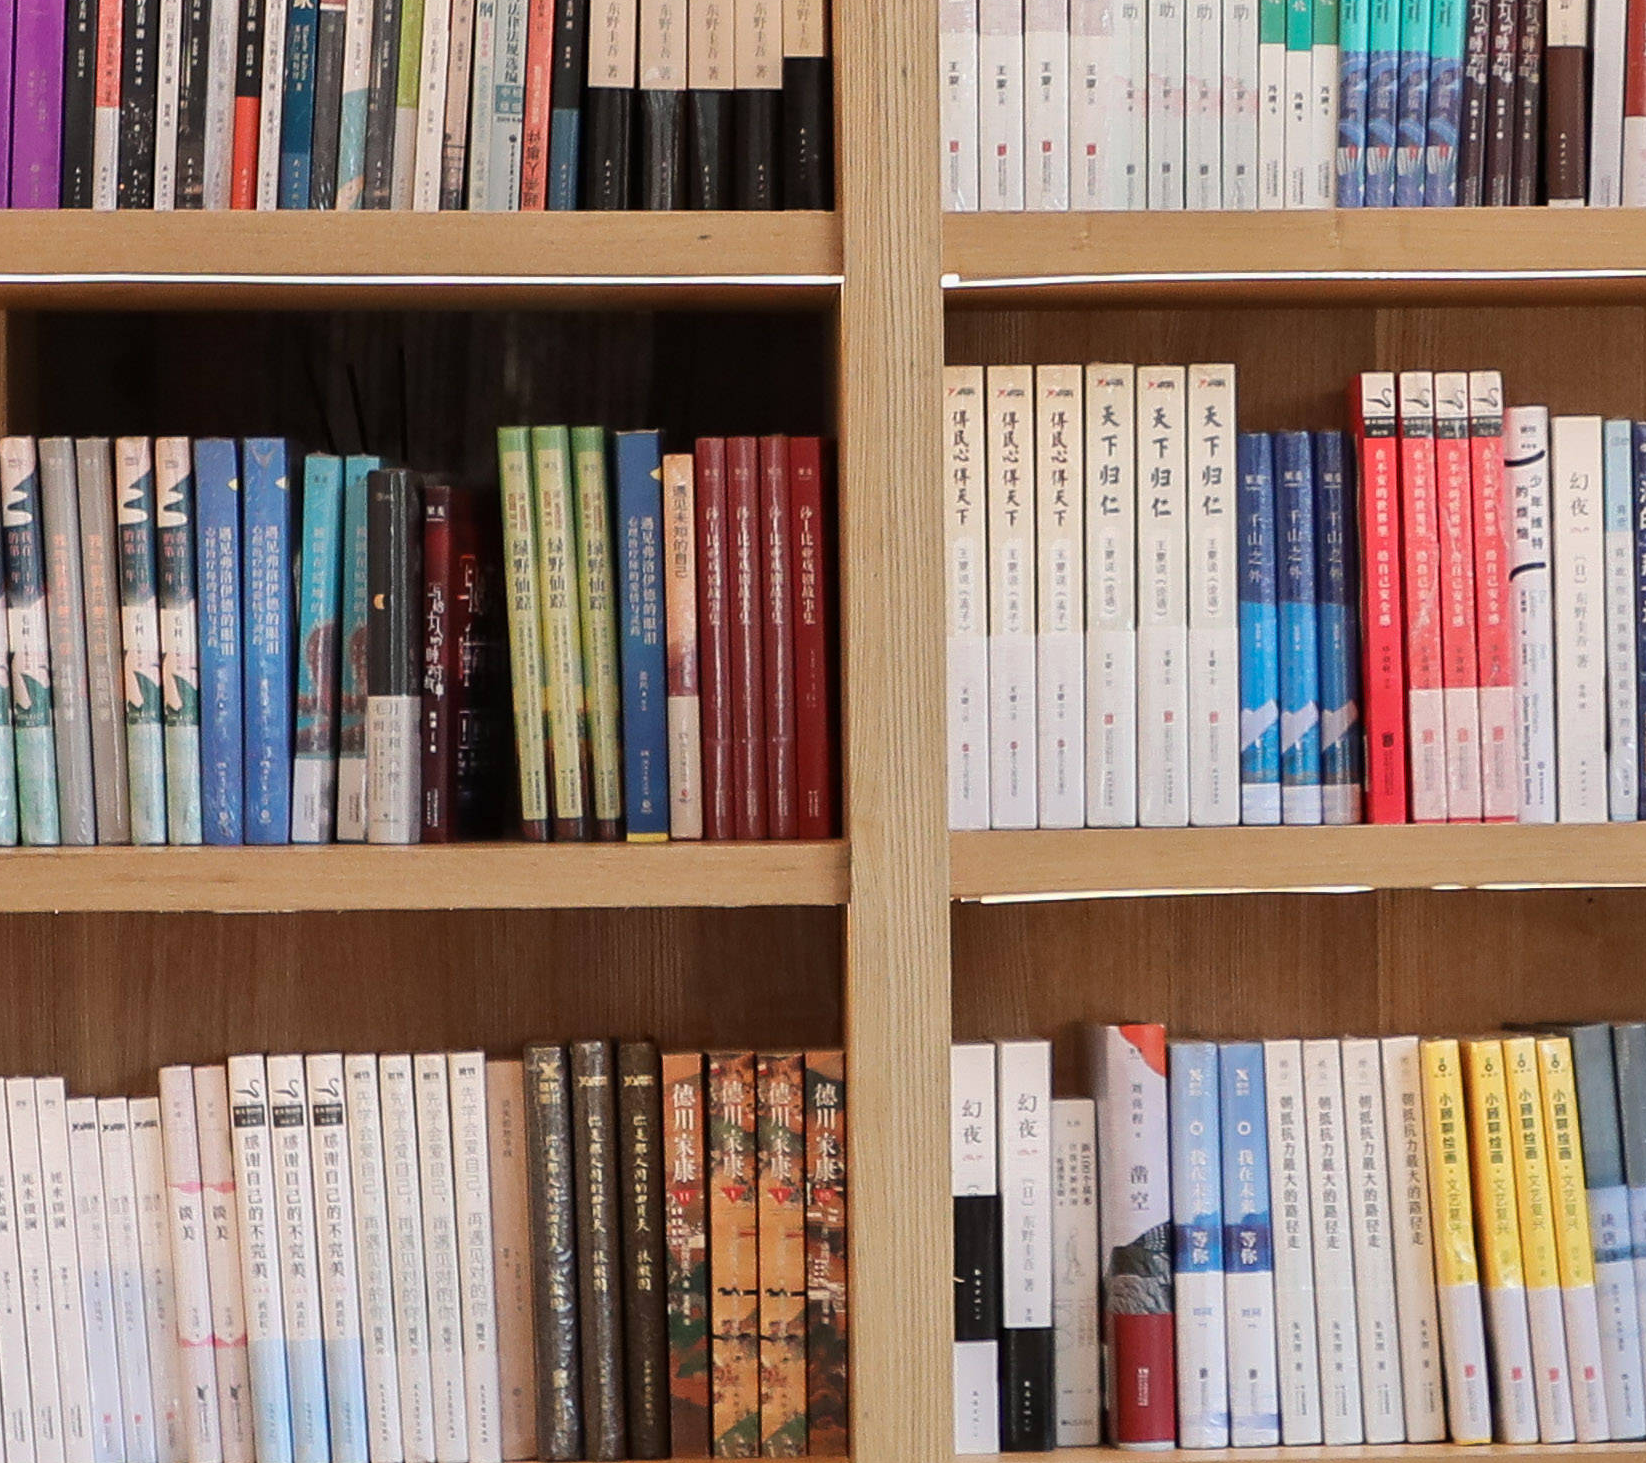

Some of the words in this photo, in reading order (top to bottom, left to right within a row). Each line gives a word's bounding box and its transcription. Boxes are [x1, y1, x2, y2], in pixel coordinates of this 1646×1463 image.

[1099, 404, 1121, 516] 天下归仁
[1150, 406, 1173, 518] 天下归仁
[1201, 405, 1224, 516] 天下归仁
[1568, 471, 1590, 519] 幻夜
[672, 484, 688, 579] 遇见未知的自己
[1515, 485, 1529, 542] 的烦恼
[1529, 475, 1544, 552] 少年维特
[512, 538, 531, 612] 绿野仙踪
[587, 539, 606, 612] 绿野仙踪
[800, 505, 816, 626] 莎士比亚戏剧故事集
[672, 1082, 697, 1185] 德川家康
[721, 1079, 745, 1180] 德川家康
[814, 1081, 839, 1184] 德川家康
[1016, 1092, 1039, 1139] 幻夜
[243, 1133, 269, 1280] 感谢自己的不完美
[323, 1132, 346, 1279] 感谢自己的不完美
[1130, 1164, 1150, 1212] 凿空
[1279, 1095, 1301, 1250] 朝抵抗力最大的路径走
[1358, 1094, 1380, 1249] 朝抵抗力最大的路径走
[179, 1204, 195, 1242] 谈美
